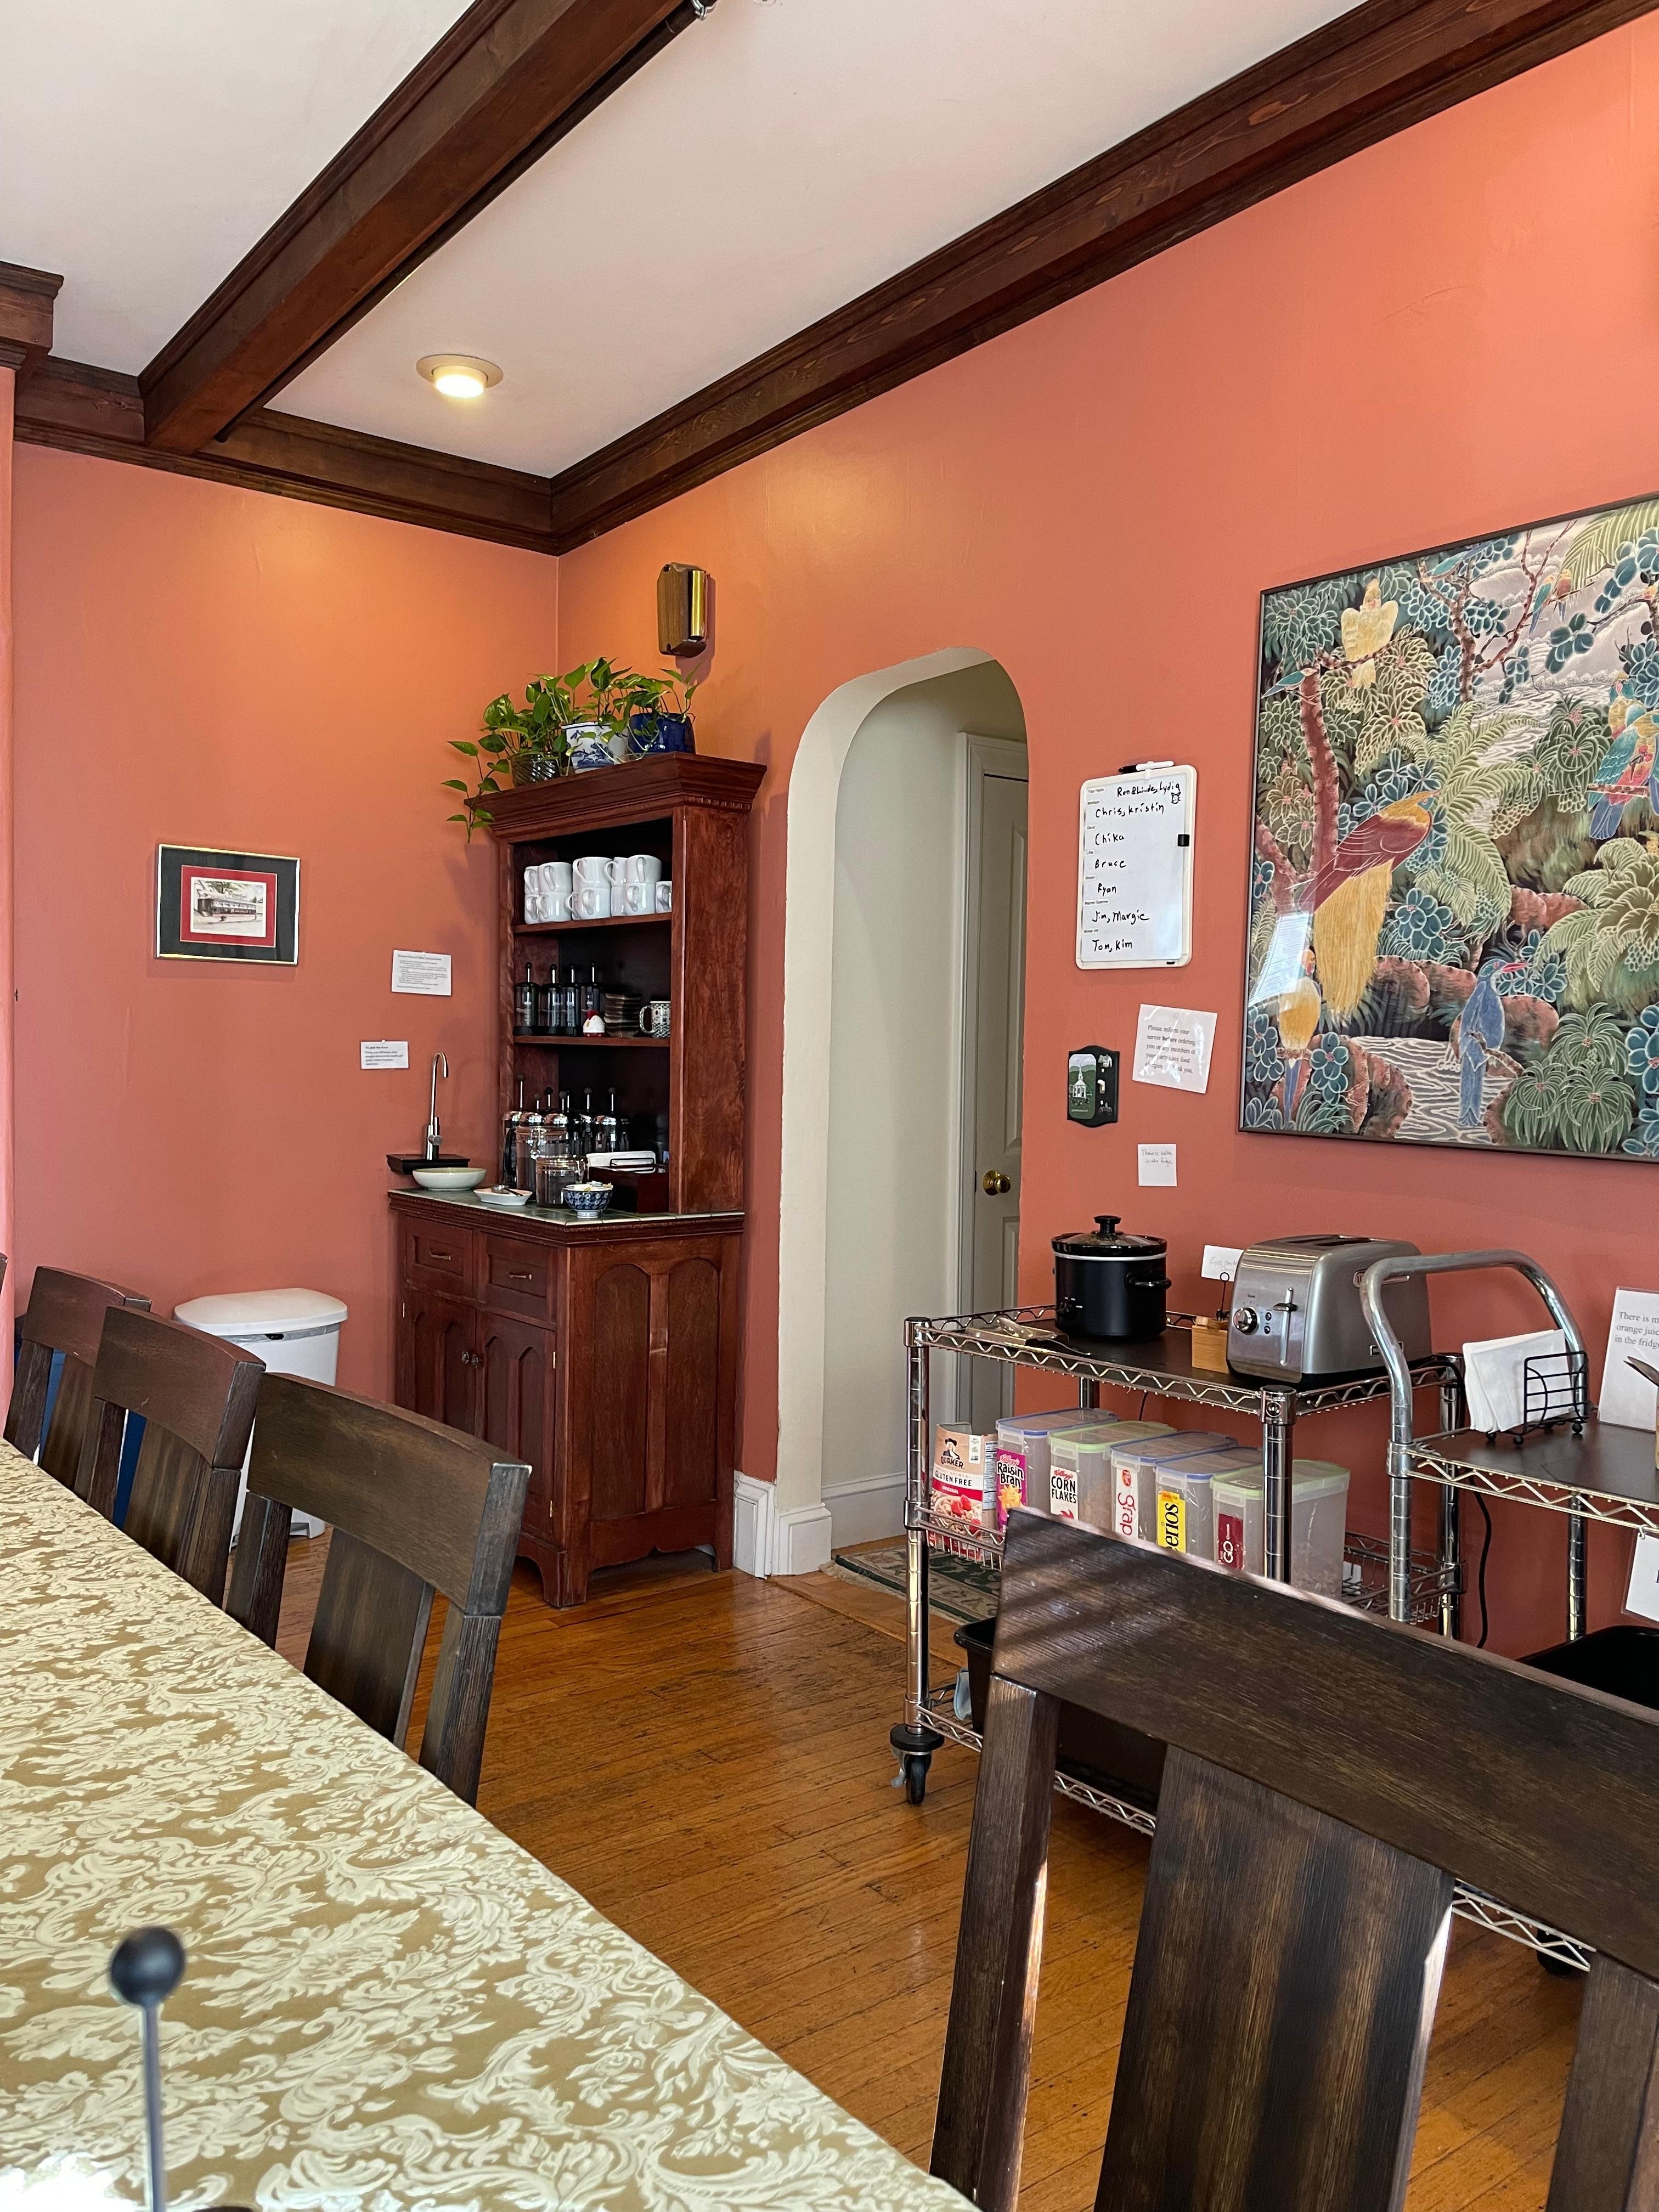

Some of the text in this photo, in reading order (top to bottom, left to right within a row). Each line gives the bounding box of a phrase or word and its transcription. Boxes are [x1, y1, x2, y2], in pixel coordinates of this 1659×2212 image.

[1096, 807, 1125, 818] Chris,
[1095, 833, 1125, 845] Chika
[1095, 859, 1126, 869] Bruce
[1098, 883, 1116, 896] Ryan
[1092, 909, 1150, 925] Jim, Margie
[1092, 939, 1132, 952] Tom, Kim
[1620, 1311, 1641, 1321] There
[1643, 1313, 1649, 1322] is
[1616, 1325, 1643, 1335] orange
[1615, 1334, 1622, 1343] in
[1624, 1336, 1637, 1345] the
[940, 1456, 964, 1469] QUAKER
[997, 1462, 1024, 1481] Raisin
[1054, 1469, 1074, 1480] Kellogg's
[935, 1470, 973, 1487] GLUTEN FREE
[1000, 1473, 1022, 1489] Bran
[1051, 1476, 1076, 1493] CORN
[1051, 1488, 1077, 1504] FLAKES
[1161, 1503, 1179, 1551] erios
[1223, 1541, 1234, 1564] GO
